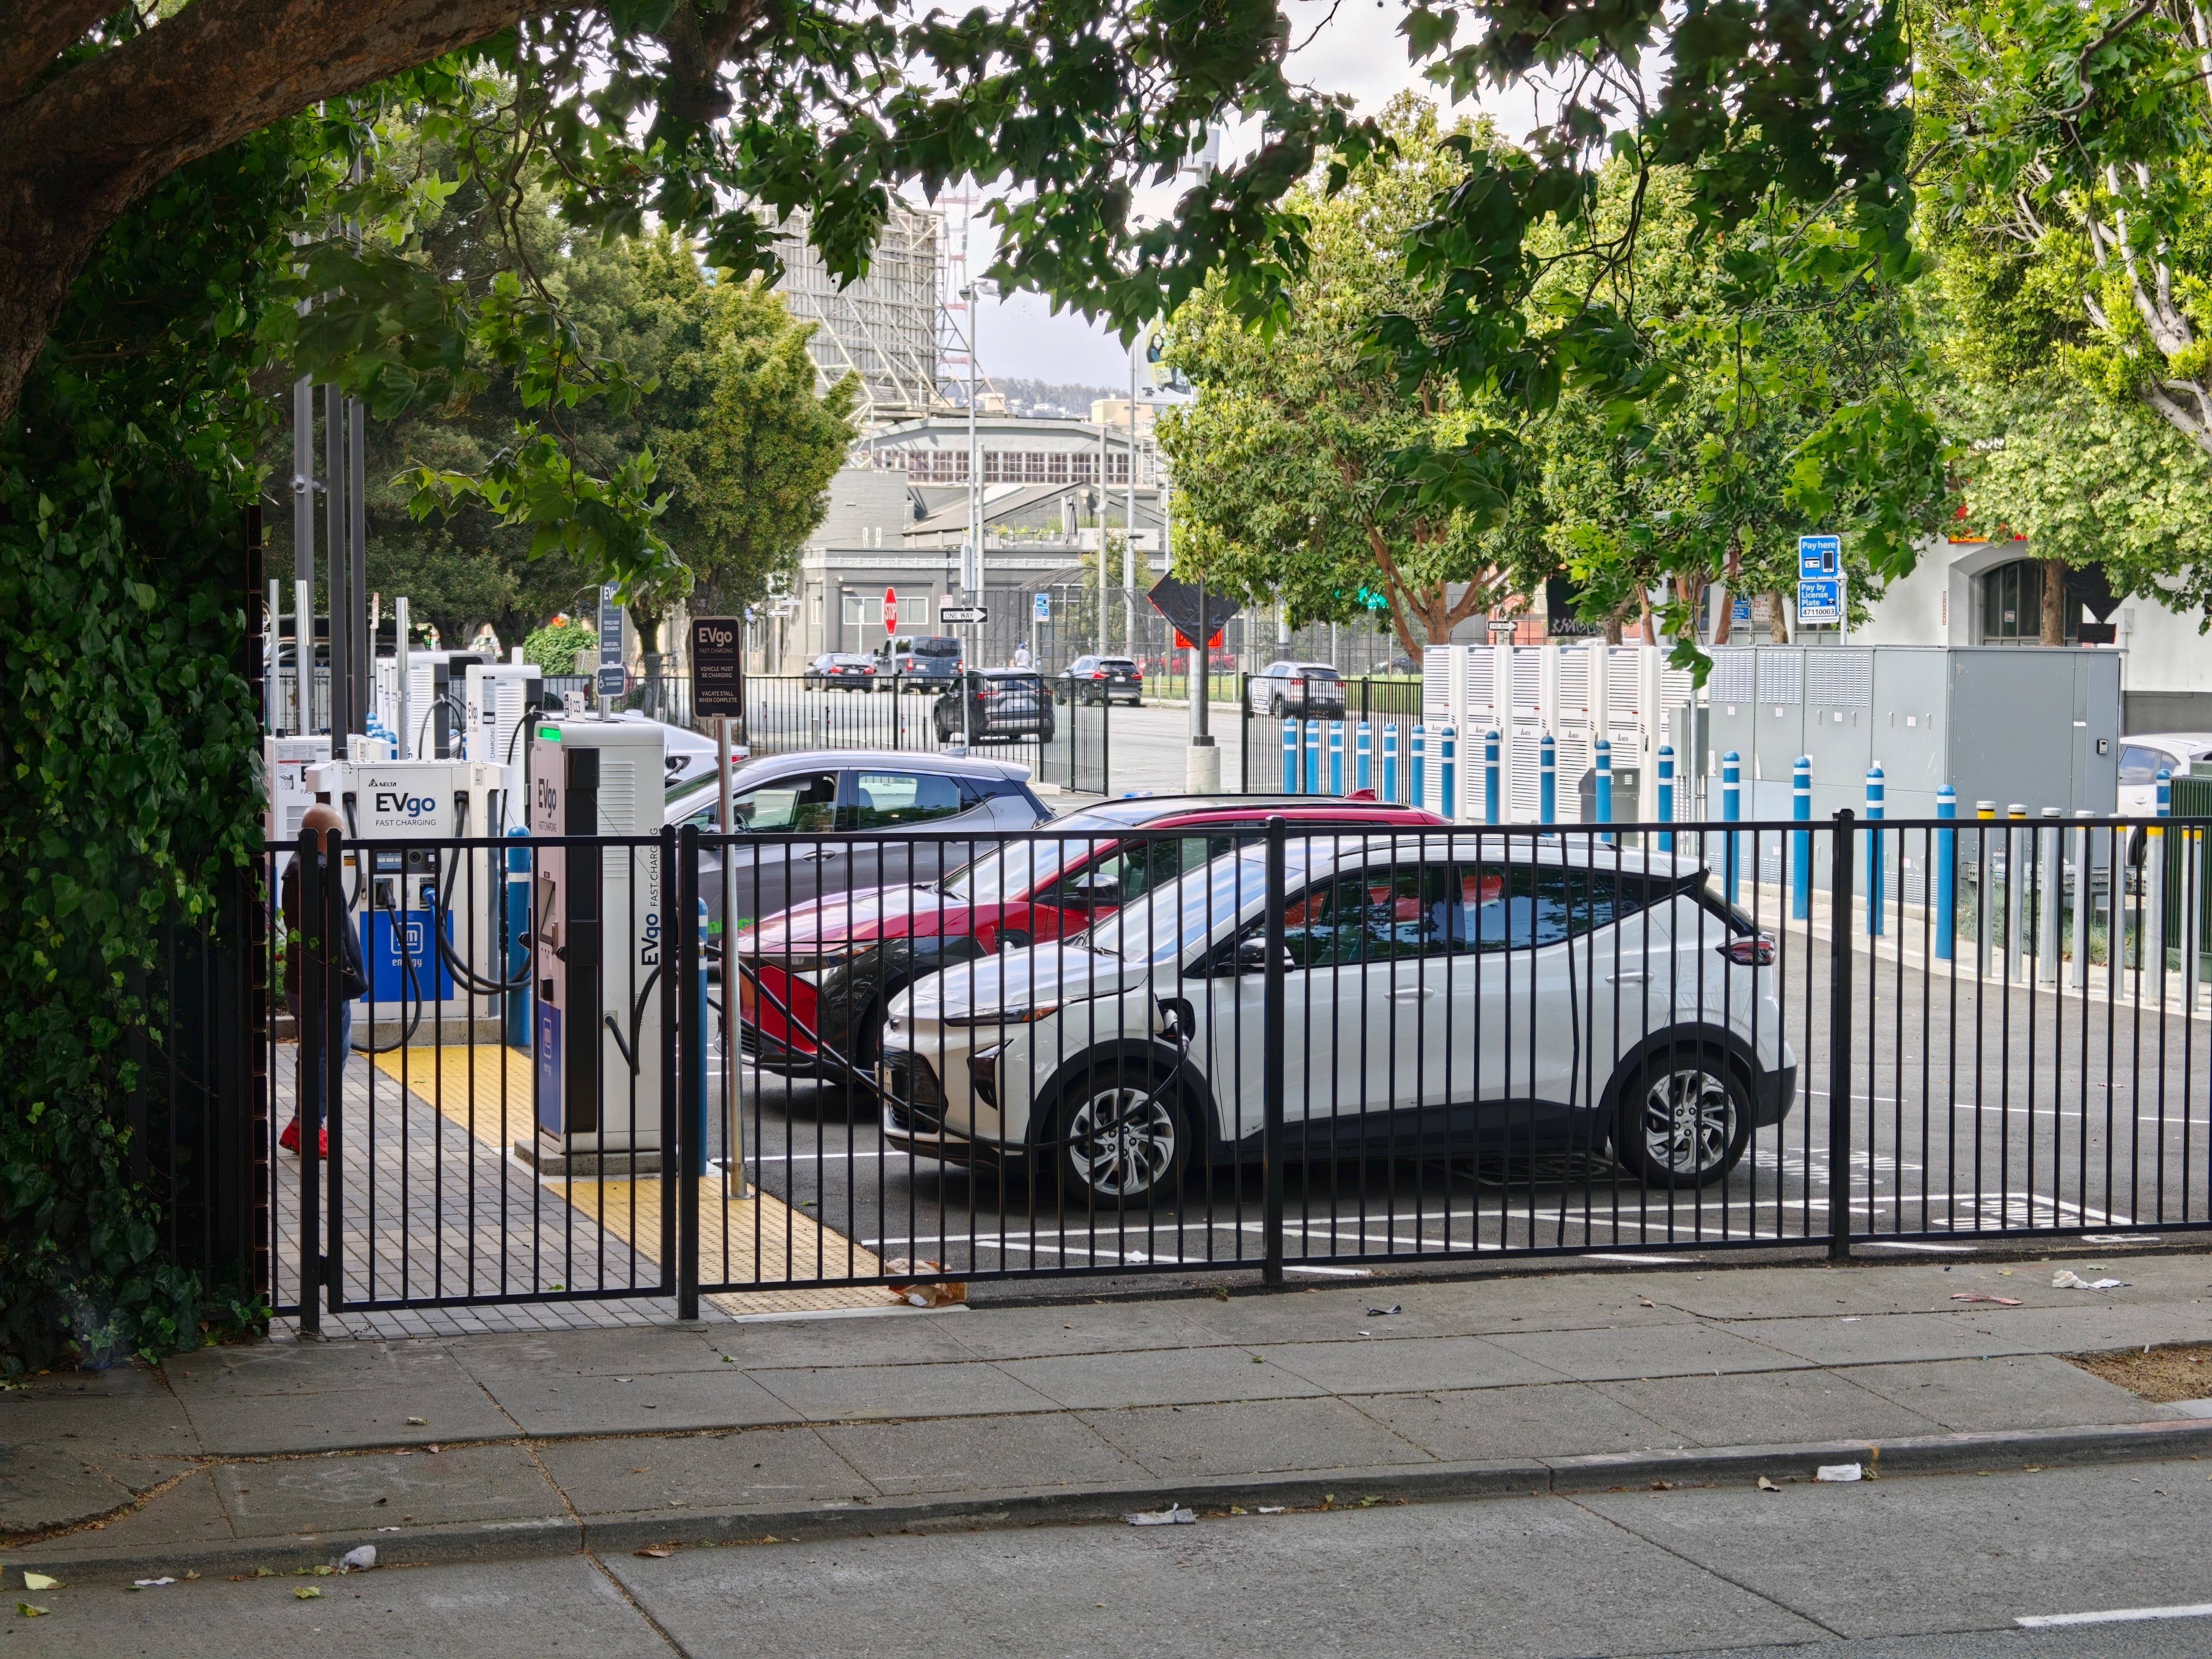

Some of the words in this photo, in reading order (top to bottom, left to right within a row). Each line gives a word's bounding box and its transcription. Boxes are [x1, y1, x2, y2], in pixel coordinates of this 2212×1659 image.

[1803, 541, 1817, 551] Pay
[1802, 584, 1815, 592] Pay
[1817, 583, 1826, 592] by
[885, 603, 896, 620] STOP
[699, 627, 732, 647] EVgo
[468, 702, 478, 725] EVgo
[376, 793, 435, 817] EVgo
[539, 778, 556, 818] EVgo
[544, 822, 556, 832] CHARGING
[641, 914, 661, 965] EVgo
[392, 959, 422, 967] engy
